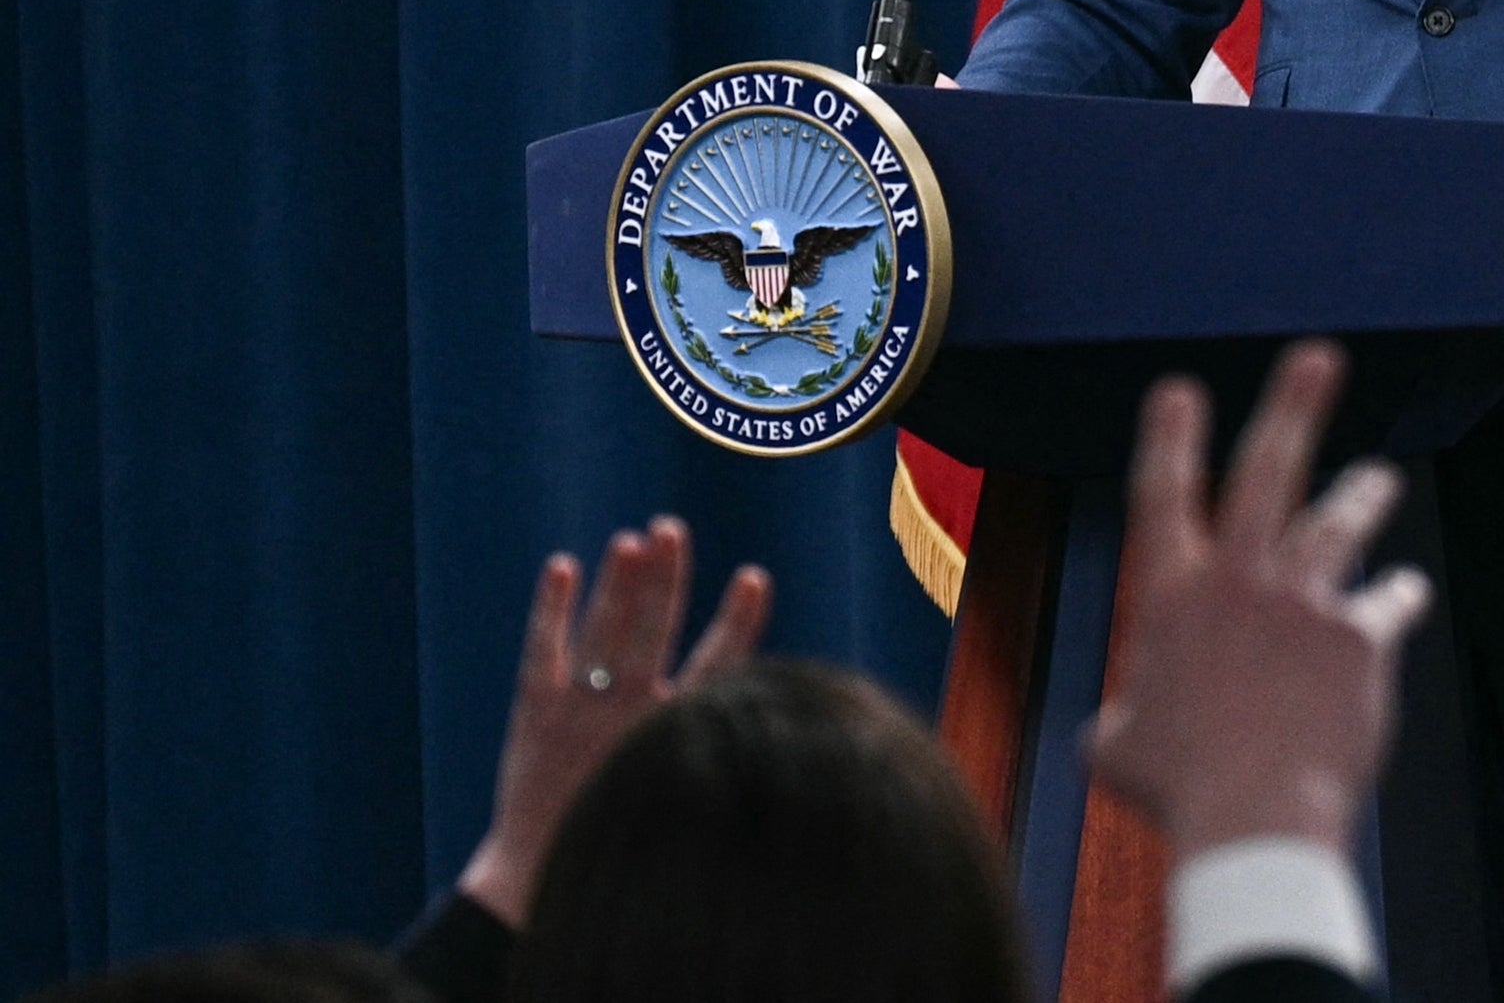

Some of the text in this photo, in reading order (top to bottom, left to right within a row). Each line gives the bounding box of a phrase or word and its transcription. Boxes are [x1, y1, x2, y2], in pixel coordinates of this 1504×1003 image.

[618, 74, 919, 248] DEPARTMENT OF WAR
[640, 324, 910, 441] UNITED STATES OF AMERICA
